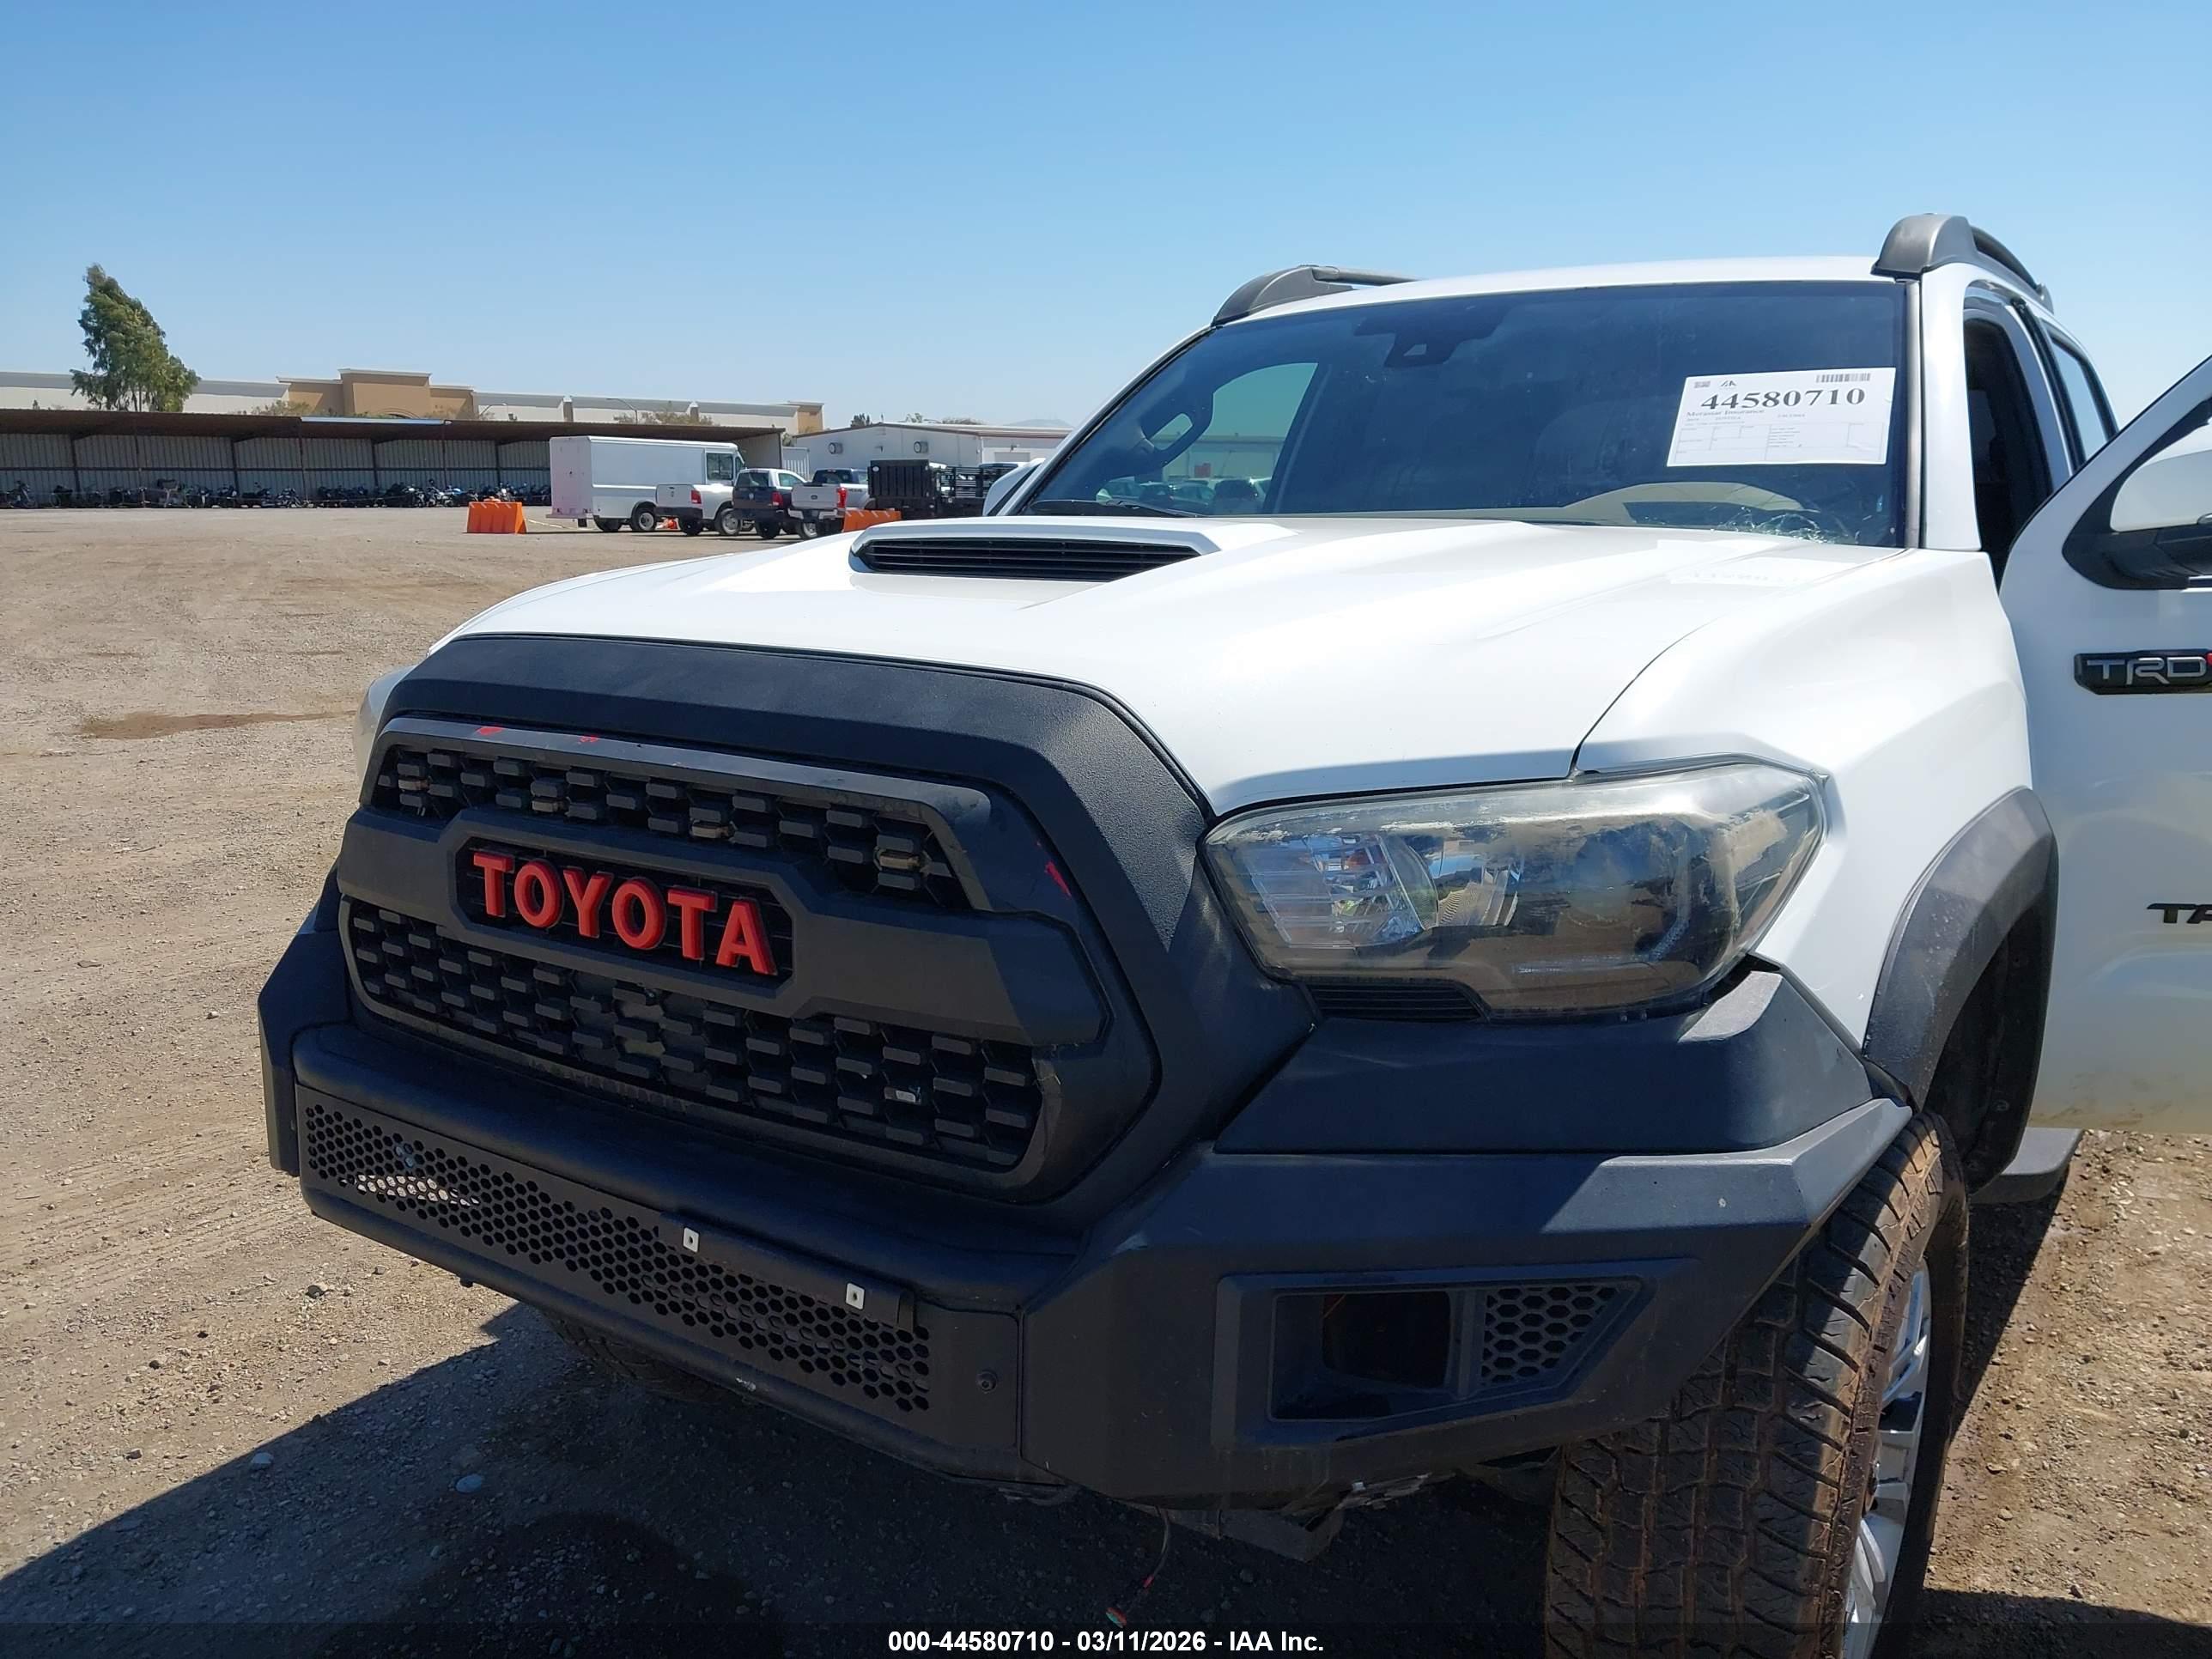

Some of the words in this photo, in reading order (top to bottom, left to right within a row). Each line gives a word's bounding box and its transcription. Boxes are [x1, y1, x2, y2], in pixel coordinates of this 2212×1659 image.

[1700, 388, 1865, 410] 44580710
[2087, 656, 2208, 685] TRD
[473, 852, 778, 975] TOYOTA
